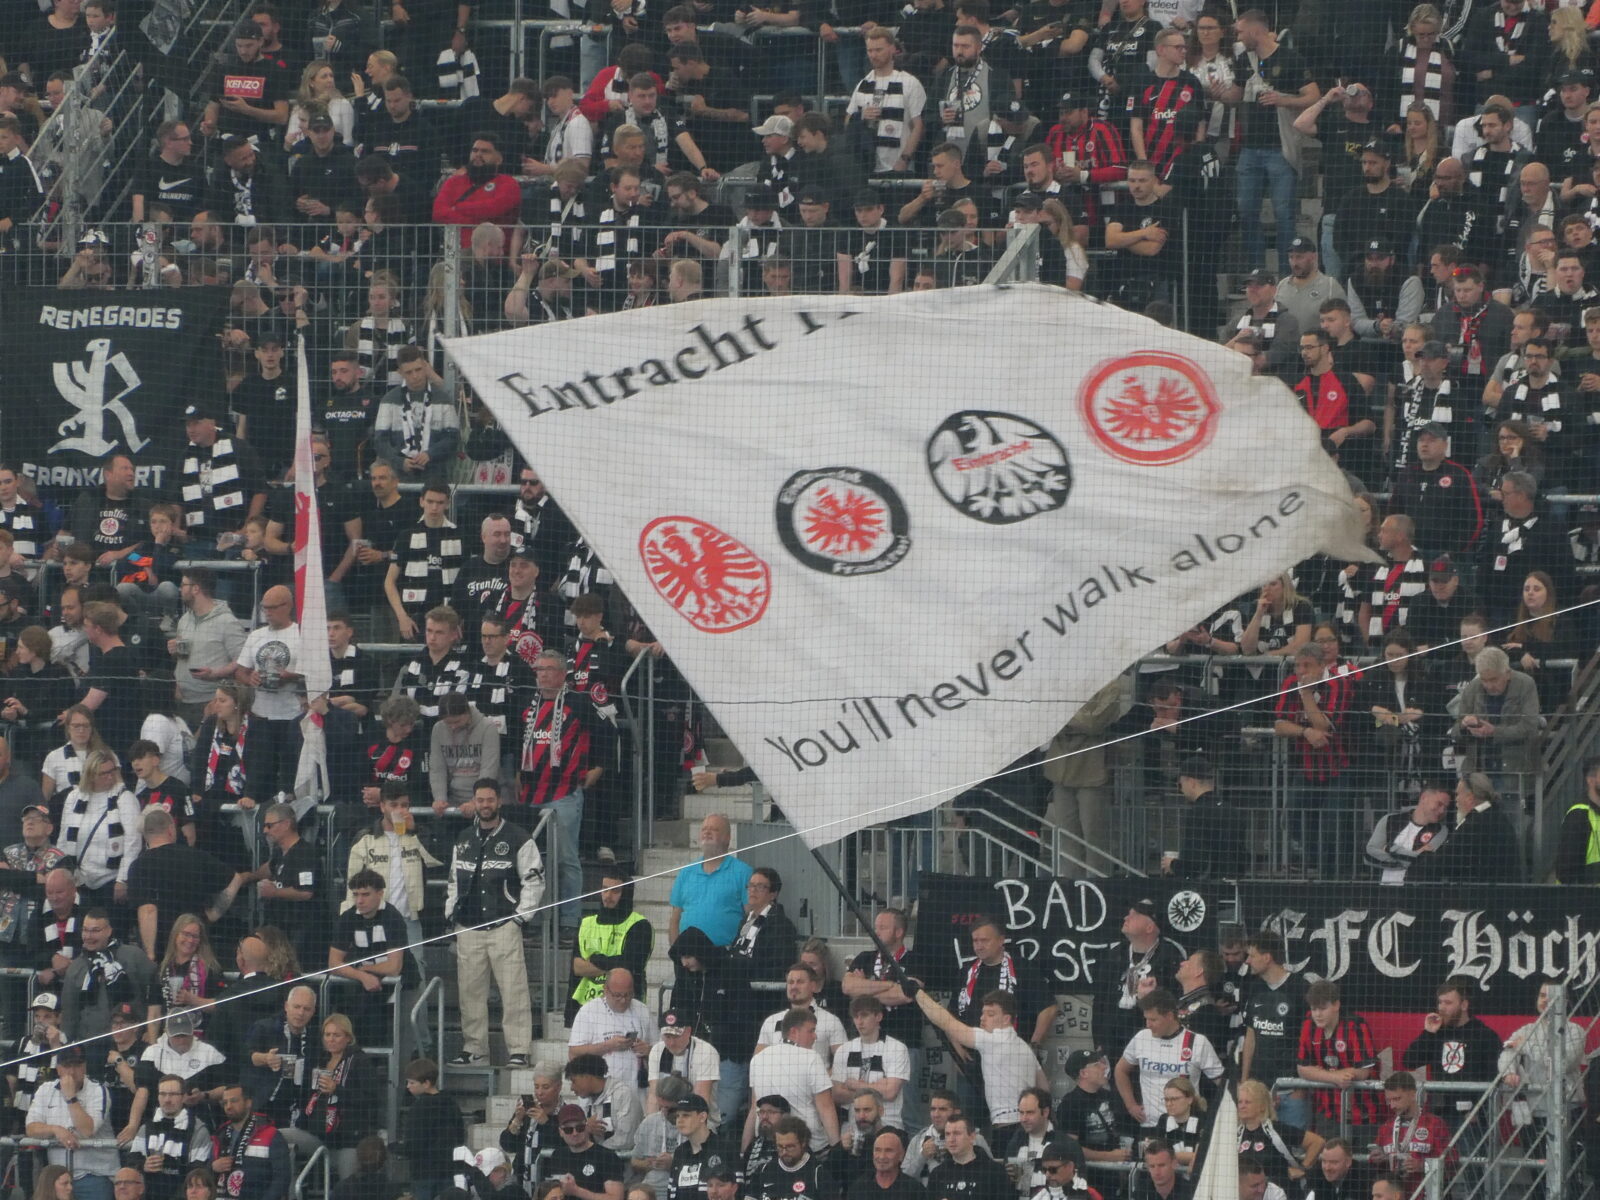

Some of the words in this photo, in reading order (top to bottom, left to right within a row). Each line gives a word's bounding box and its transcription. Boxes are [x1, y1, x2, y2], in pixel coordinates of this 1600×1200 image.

[226, 79, 260, 89] KENZO
[39, 305, 182, 330] RENEGADES
[22, 463, 165, 489] FRANKRT
[764, 697, 892, 772] You'll
[896, 630, 1034, 728] never
[1042, 565, 1157, 636] walk
[1171, 491, 1306, 572] alone
[994, 879, 1107, 932] BAD
[1260, 908, 1421, 984] EFC
[1253, 1016, 1284, 1031] indeed
[1142, 1057, 1190, 1074] Fraport
